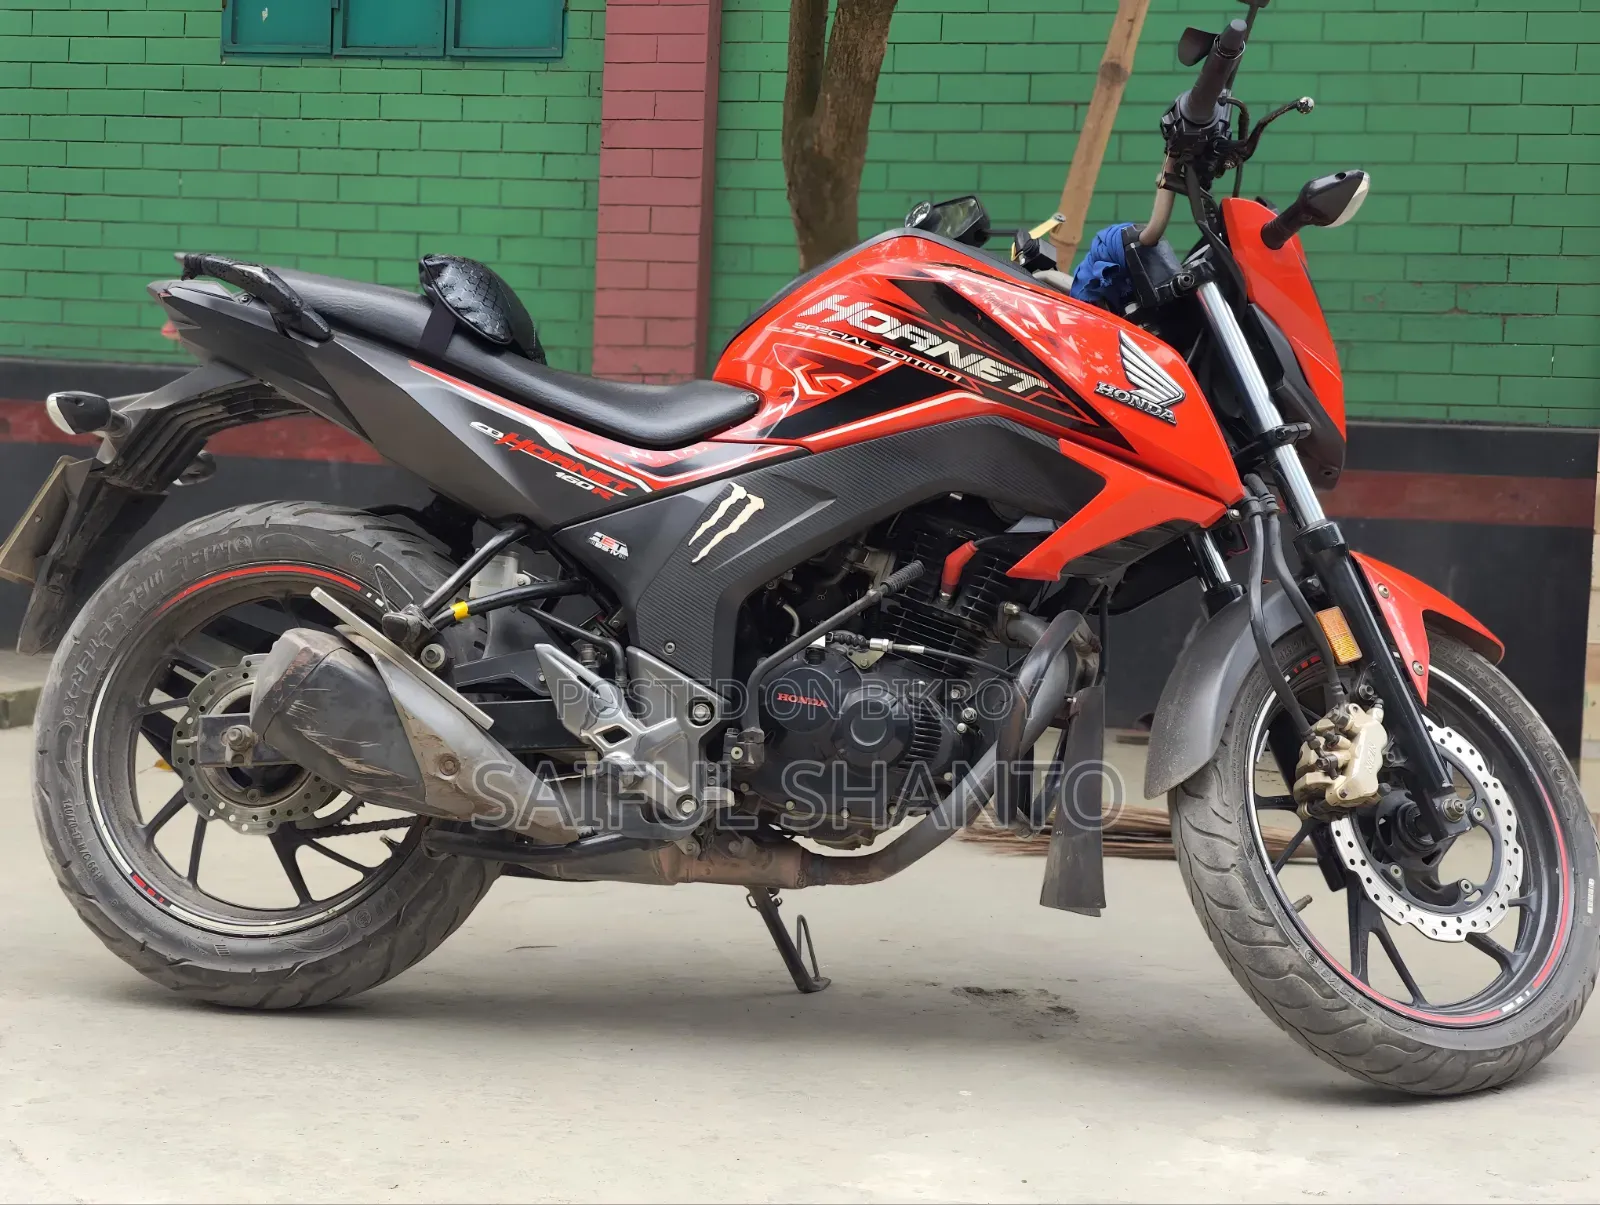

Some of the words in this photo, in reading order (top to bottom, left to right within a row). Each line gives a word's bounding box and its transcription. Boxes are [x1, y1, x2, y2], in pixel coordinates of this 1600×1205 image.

[791, 321, 872, 349] SPECIAL
[876, 346, 962, 382] EDITION
[797, 294, 1049, 393] HORNET
[1094, 381, 1177, 426] HONDA
[493, 432, 636, 494] HORNET
[555, 471, 614, 500] 160R
[777, 692, 828, 708] HONDA
[62, 798, 84, 841] 140/70-17
